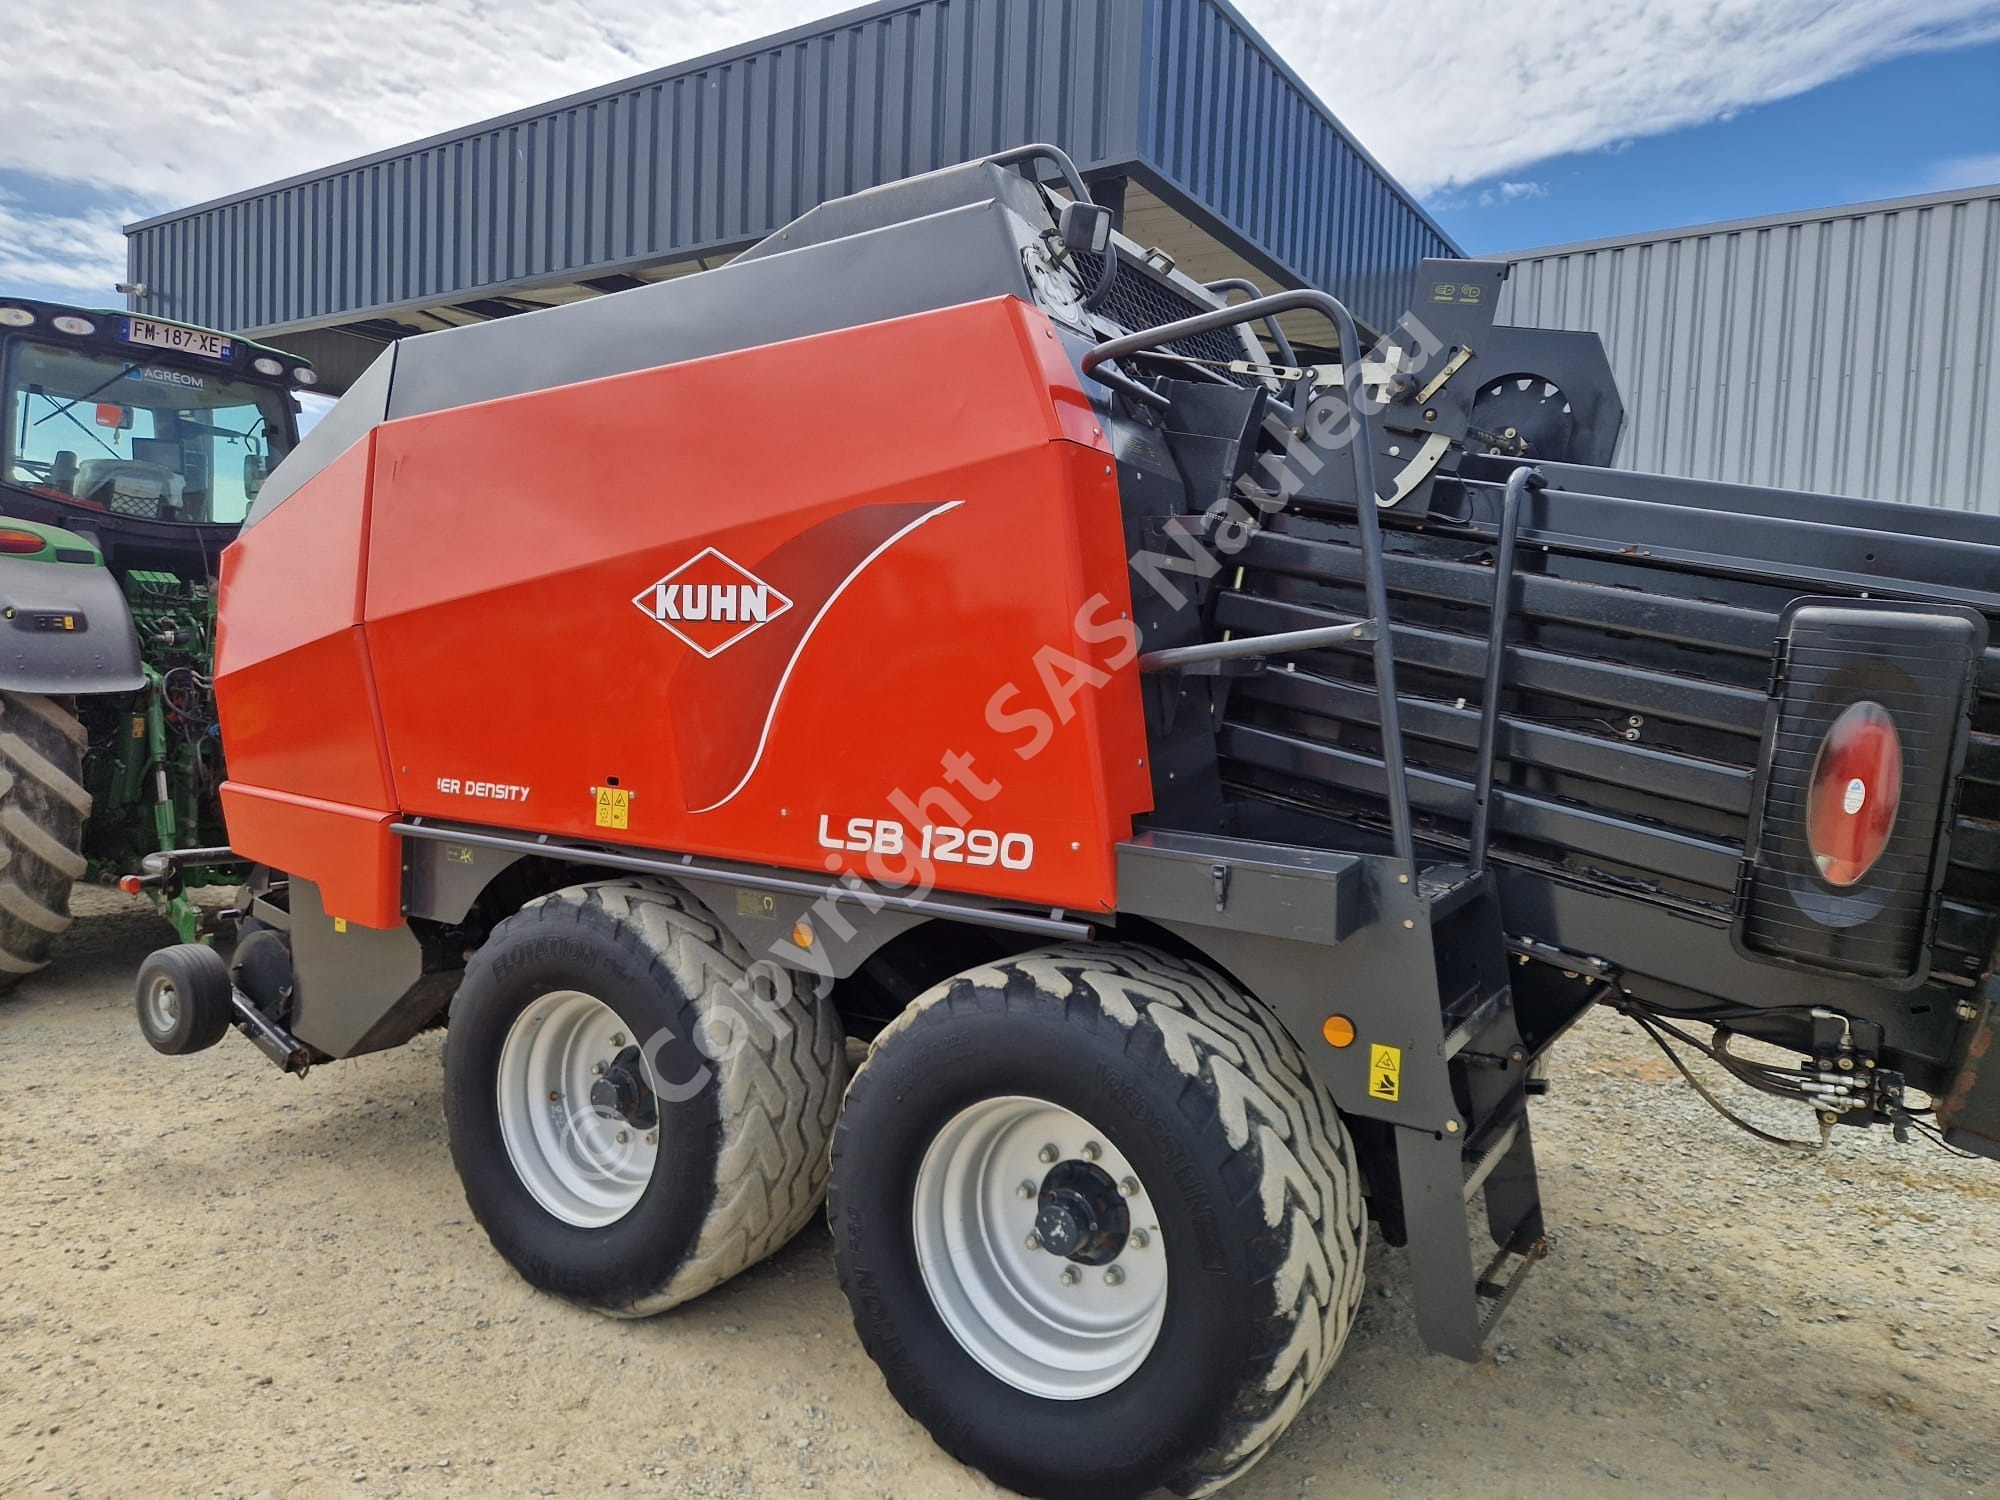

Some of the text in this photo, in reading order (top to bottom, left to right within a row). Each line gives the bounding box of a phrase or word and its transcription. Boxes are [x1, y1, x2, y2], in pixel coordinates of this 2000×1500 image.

[134, 321, 220, 353] FM-187-XE
[655, 584, 768, 623] KUHN
[464, 780, 530, 802] DENSITY
[818, 814, 1034, 871] LSB 1290
